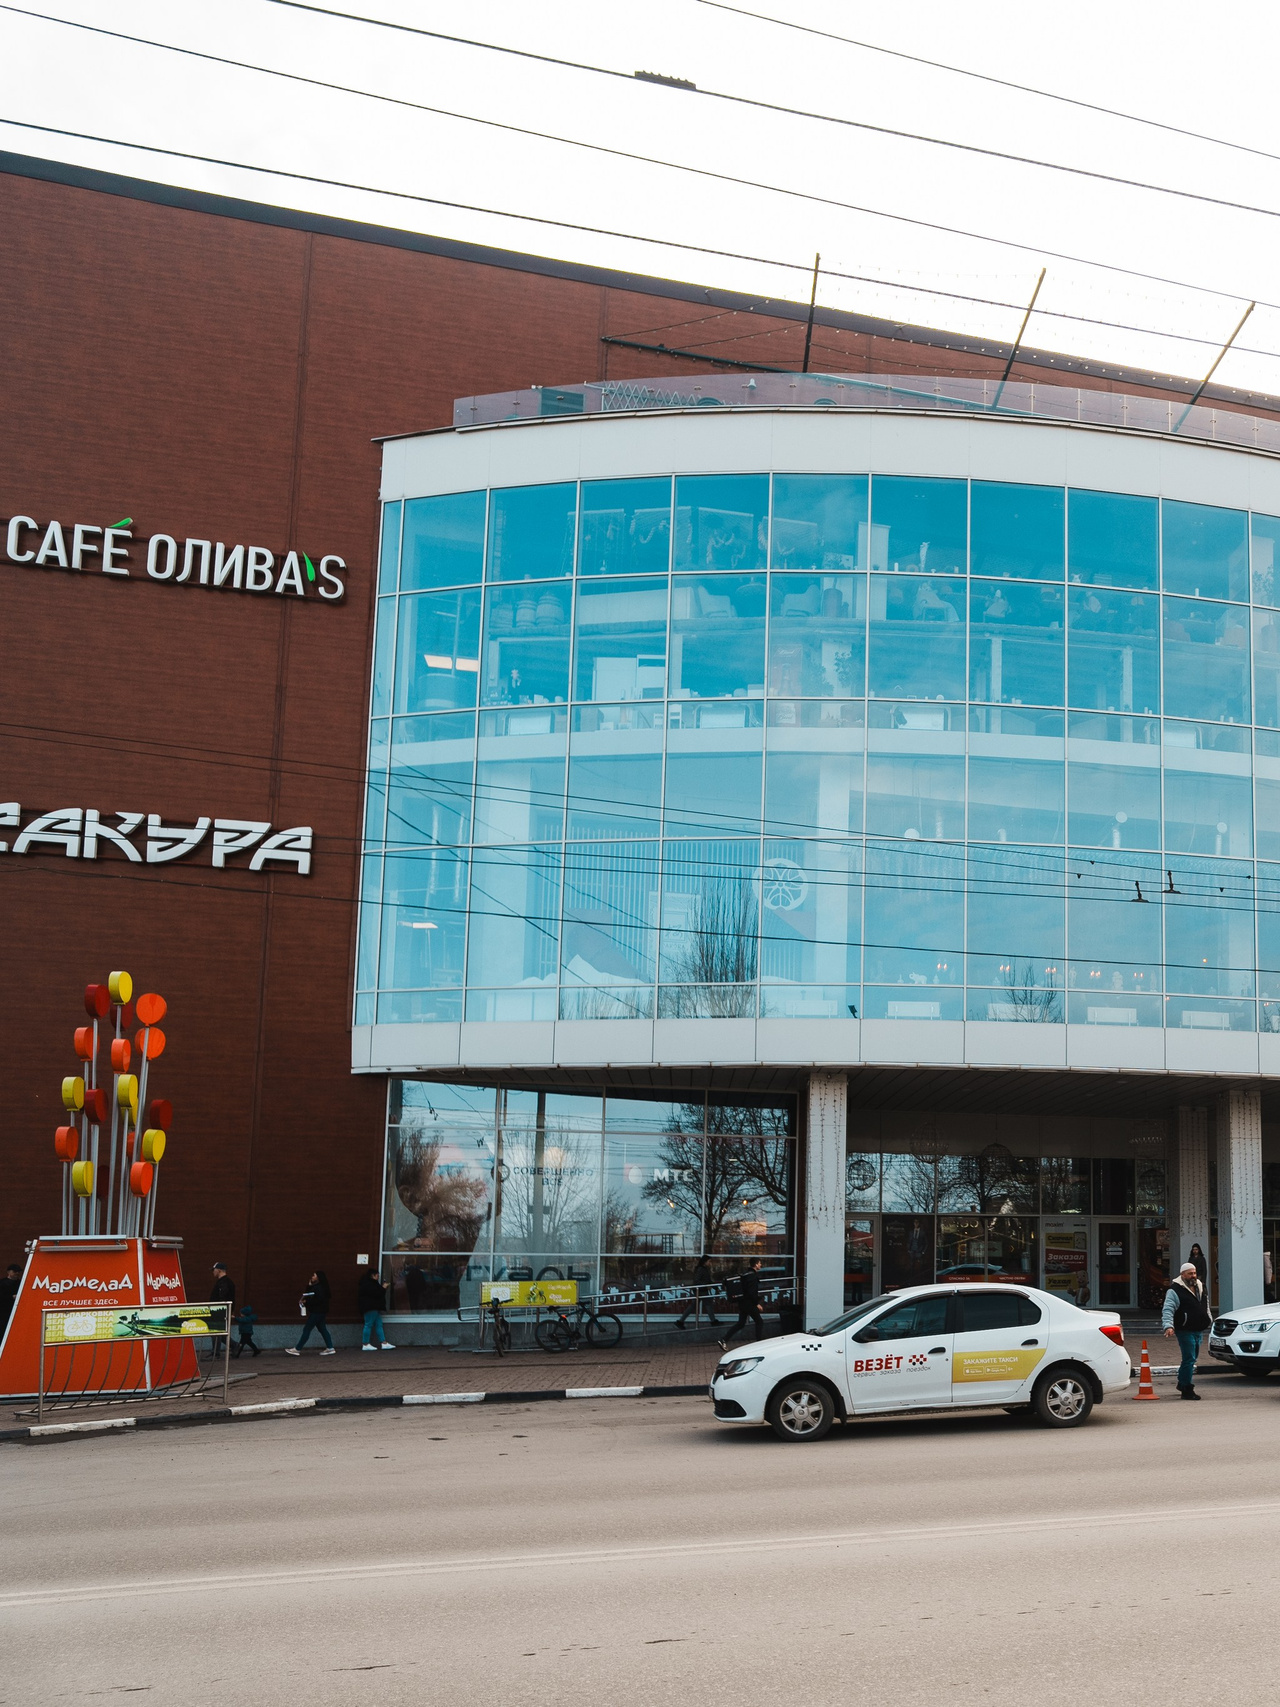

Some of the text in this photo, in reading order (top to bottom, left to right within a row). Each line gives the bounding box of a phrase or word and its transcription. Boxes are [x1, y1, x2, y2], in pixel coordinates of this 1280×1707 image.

[6, 515, 134, 577] CAFÉ
[653, 1168, 693, 1182] МТС
[47, 1310, 114, 1319] ВЕЛОПАРКОВКА
[853, 1354, 904, 1373] ВЕЗЁТ
[963, 1357, 997, 1365] ЗАКАЖИТЕ
